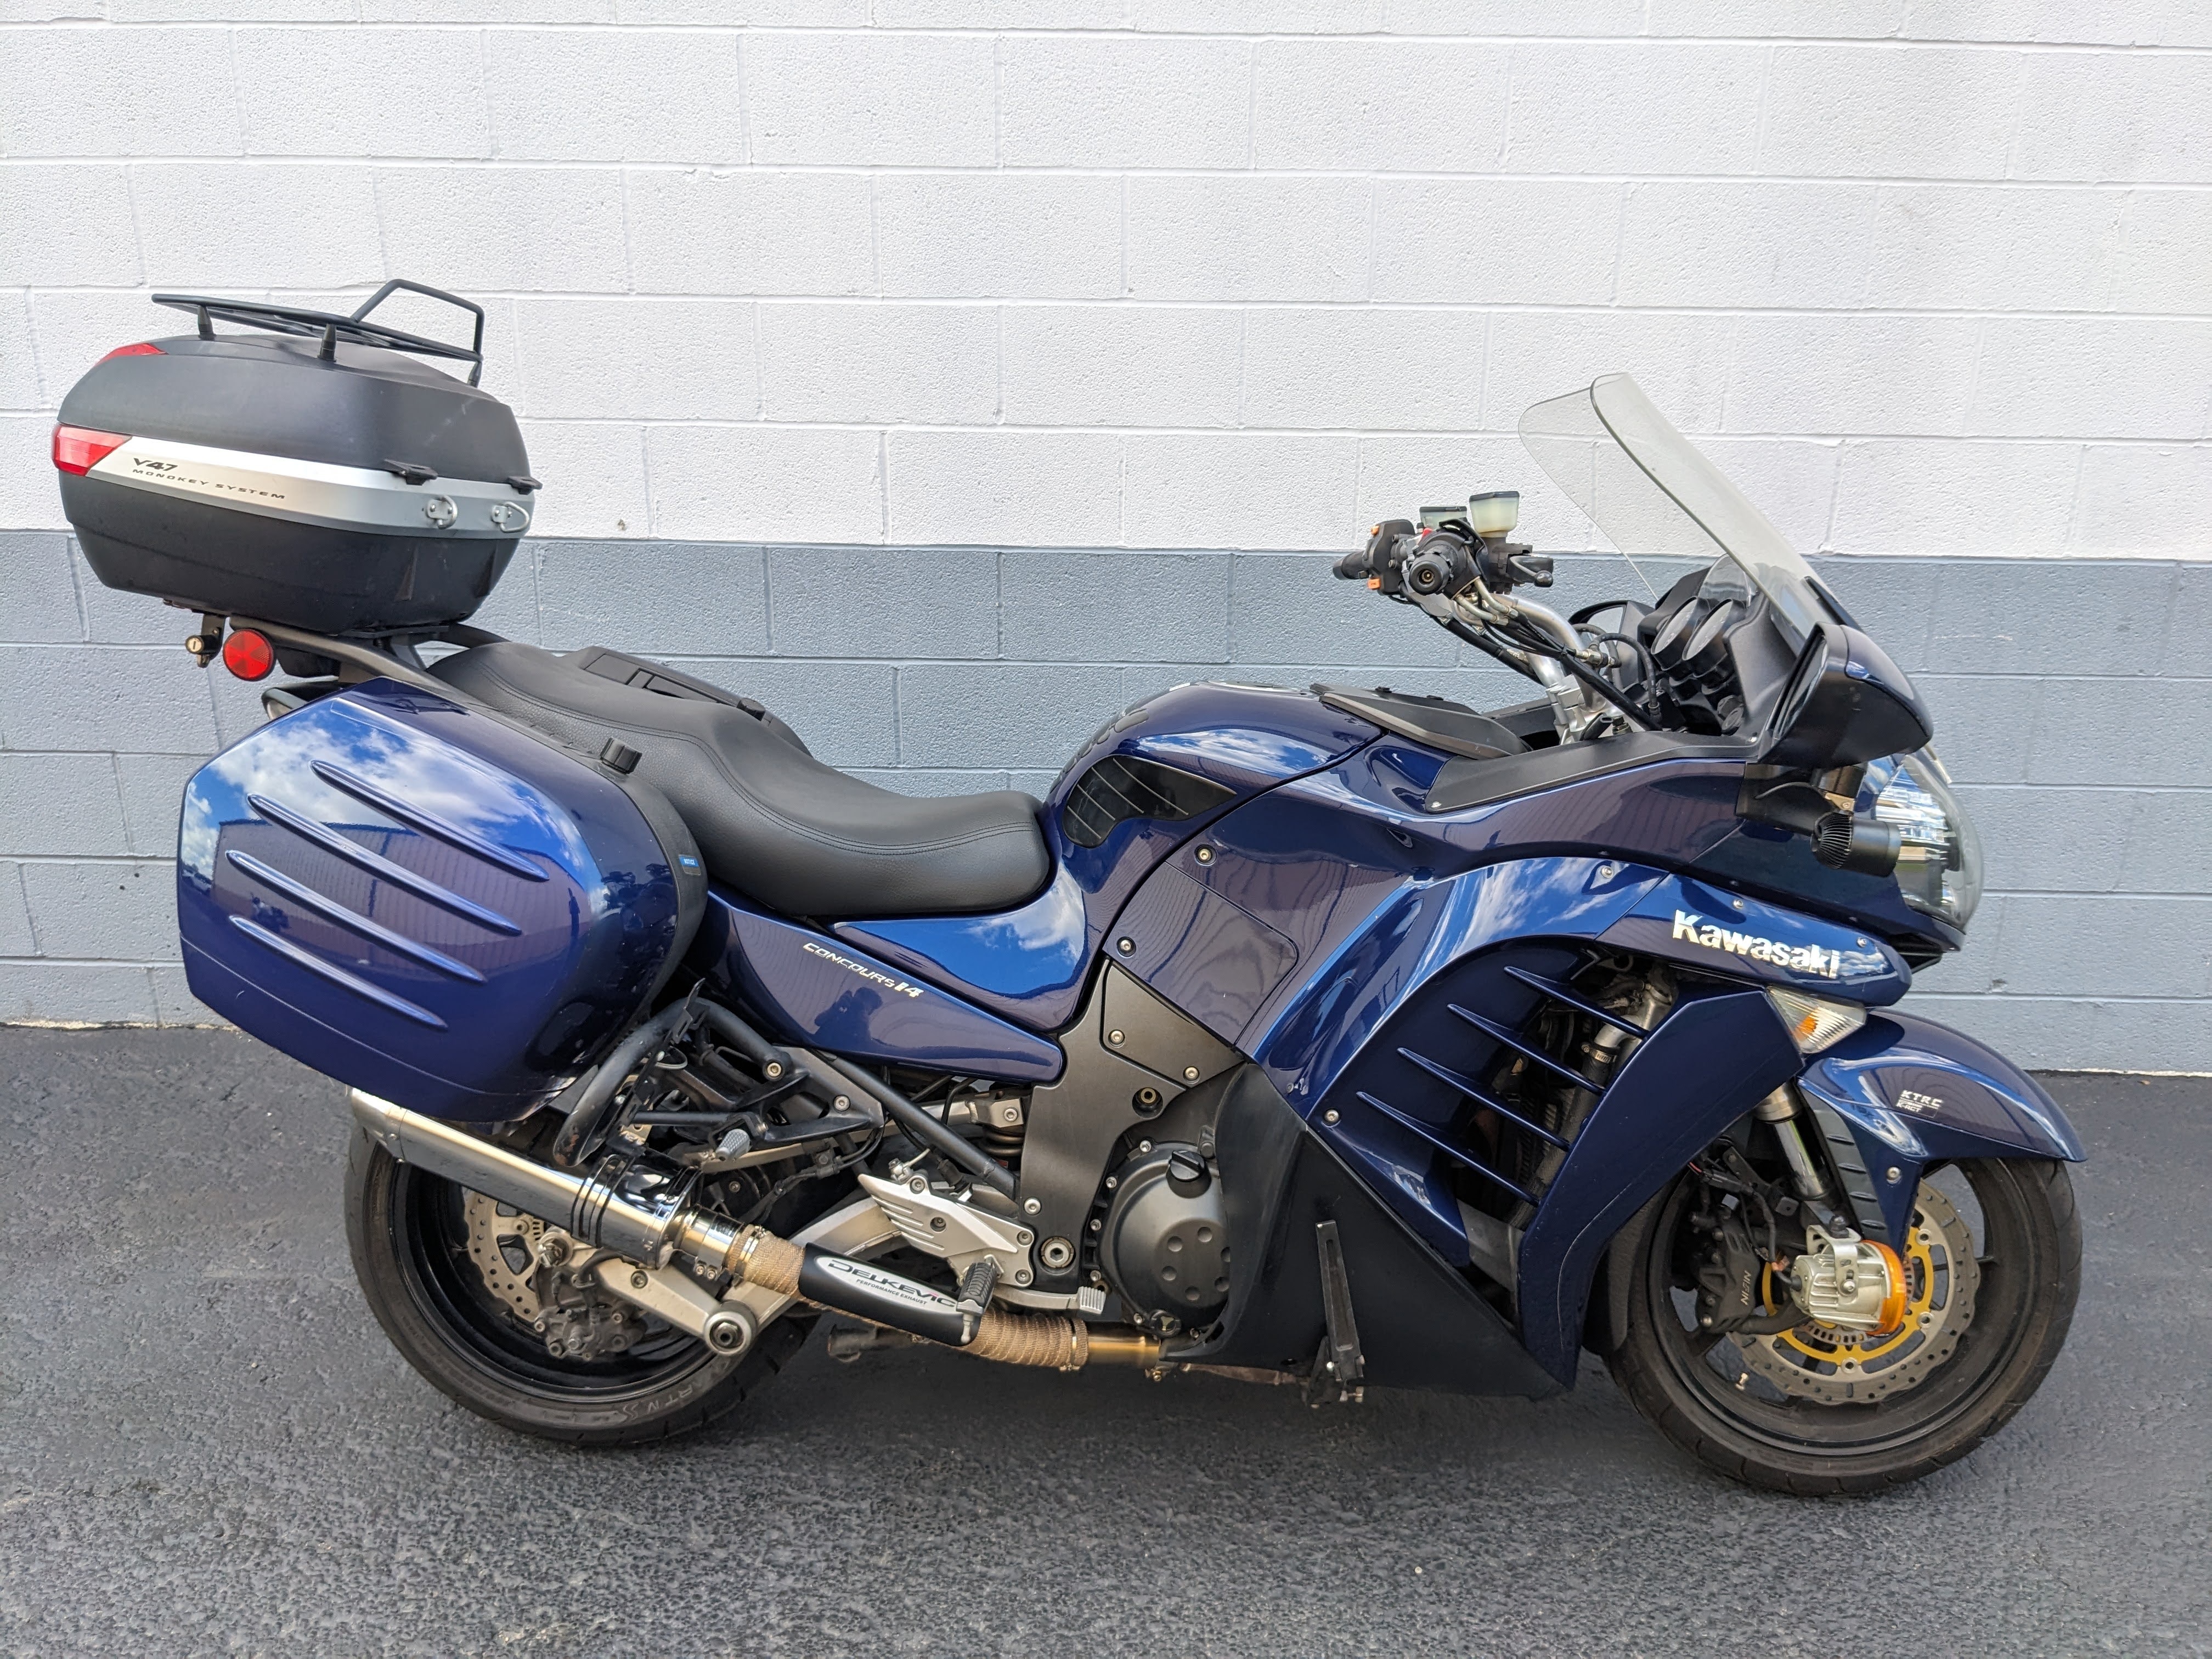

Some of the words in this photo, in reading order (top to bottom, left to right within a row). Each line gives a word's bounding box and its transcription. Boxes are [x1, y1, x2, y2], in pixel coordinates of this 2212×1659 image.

[133, 458, 178, 471] V47
[132, 469, 209, 486] MONOKEY
[215, 483, 286, 499] SYSTEM
[1672, 909, 1841, 979] Kawasaki
[803, 942, 895, 988] CONCOURS
[894, 981, 924, 998] 14
[1900, 1090, 1943, 1107] KTRC
[828, 1259, 956, 1307] DELKEVIC
[856, 1278, 900, 1296] PERFORMANCE
[900, 1293, 928, 1305] EXHAUST
